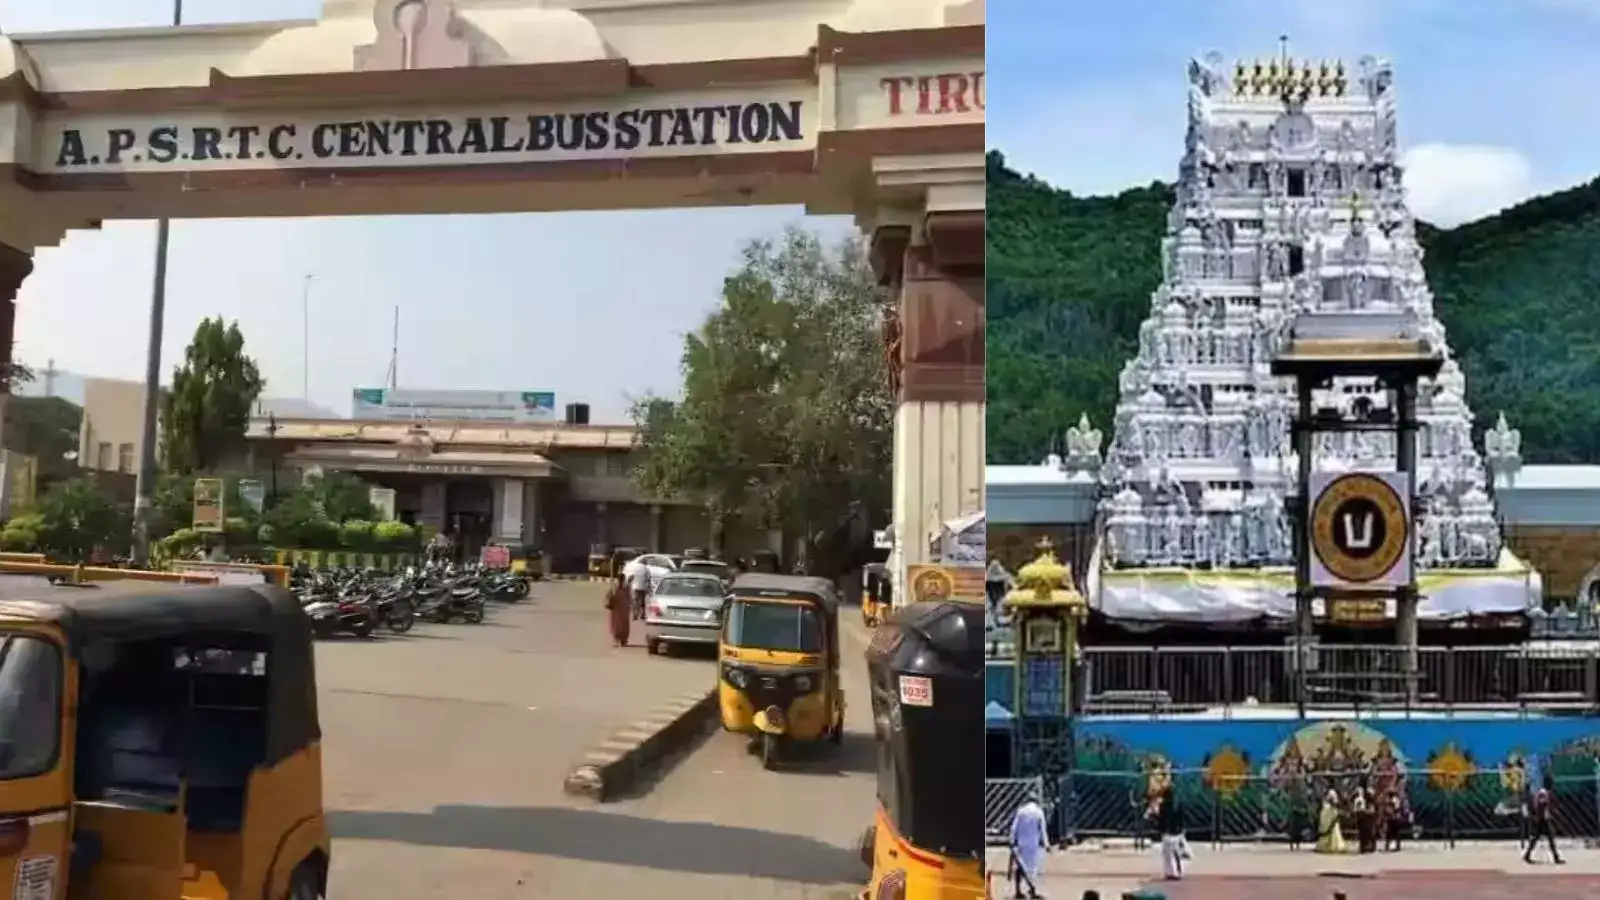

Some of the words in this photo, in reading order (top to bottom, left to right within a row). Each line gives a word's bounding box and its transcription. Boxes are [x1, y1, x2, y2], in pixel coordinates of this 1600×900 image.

[55, 123, 304, 167] A.P.S.R.T.C.
[311, 116, 525, 158] CENTRAL
[525, 111, 610, 152] BUS
[613, 101, 804, 151] STATION
